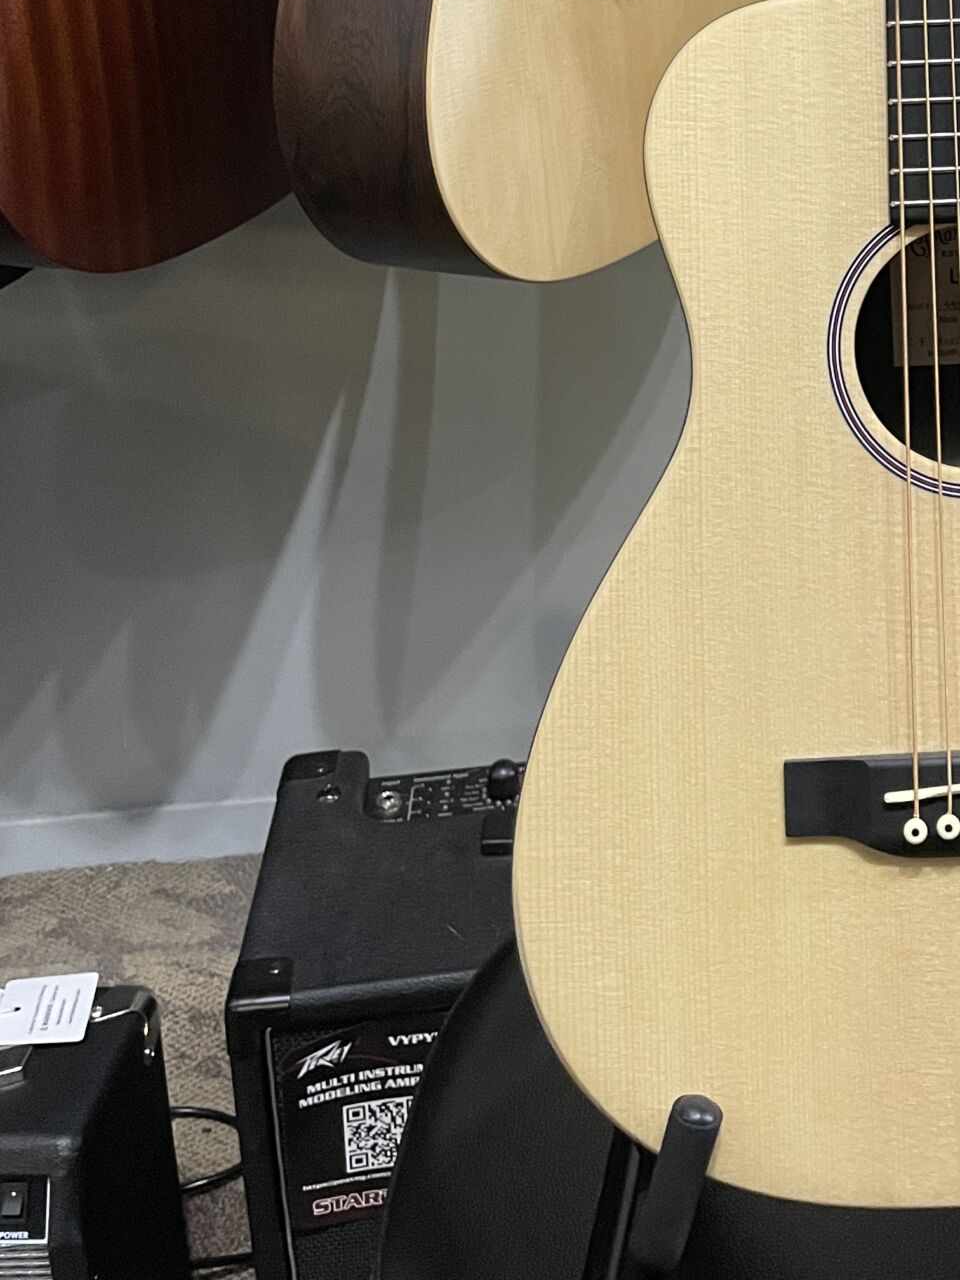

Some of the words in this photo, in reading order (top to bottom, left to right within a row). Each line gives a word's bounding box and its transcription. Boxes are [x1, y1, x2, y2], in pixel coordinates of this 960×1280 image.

[387, 1031, 439, 1047] VYPY
[298, 1080, 382, 1109] MODELING
[306, 1073, 356, 1095] MULTI
